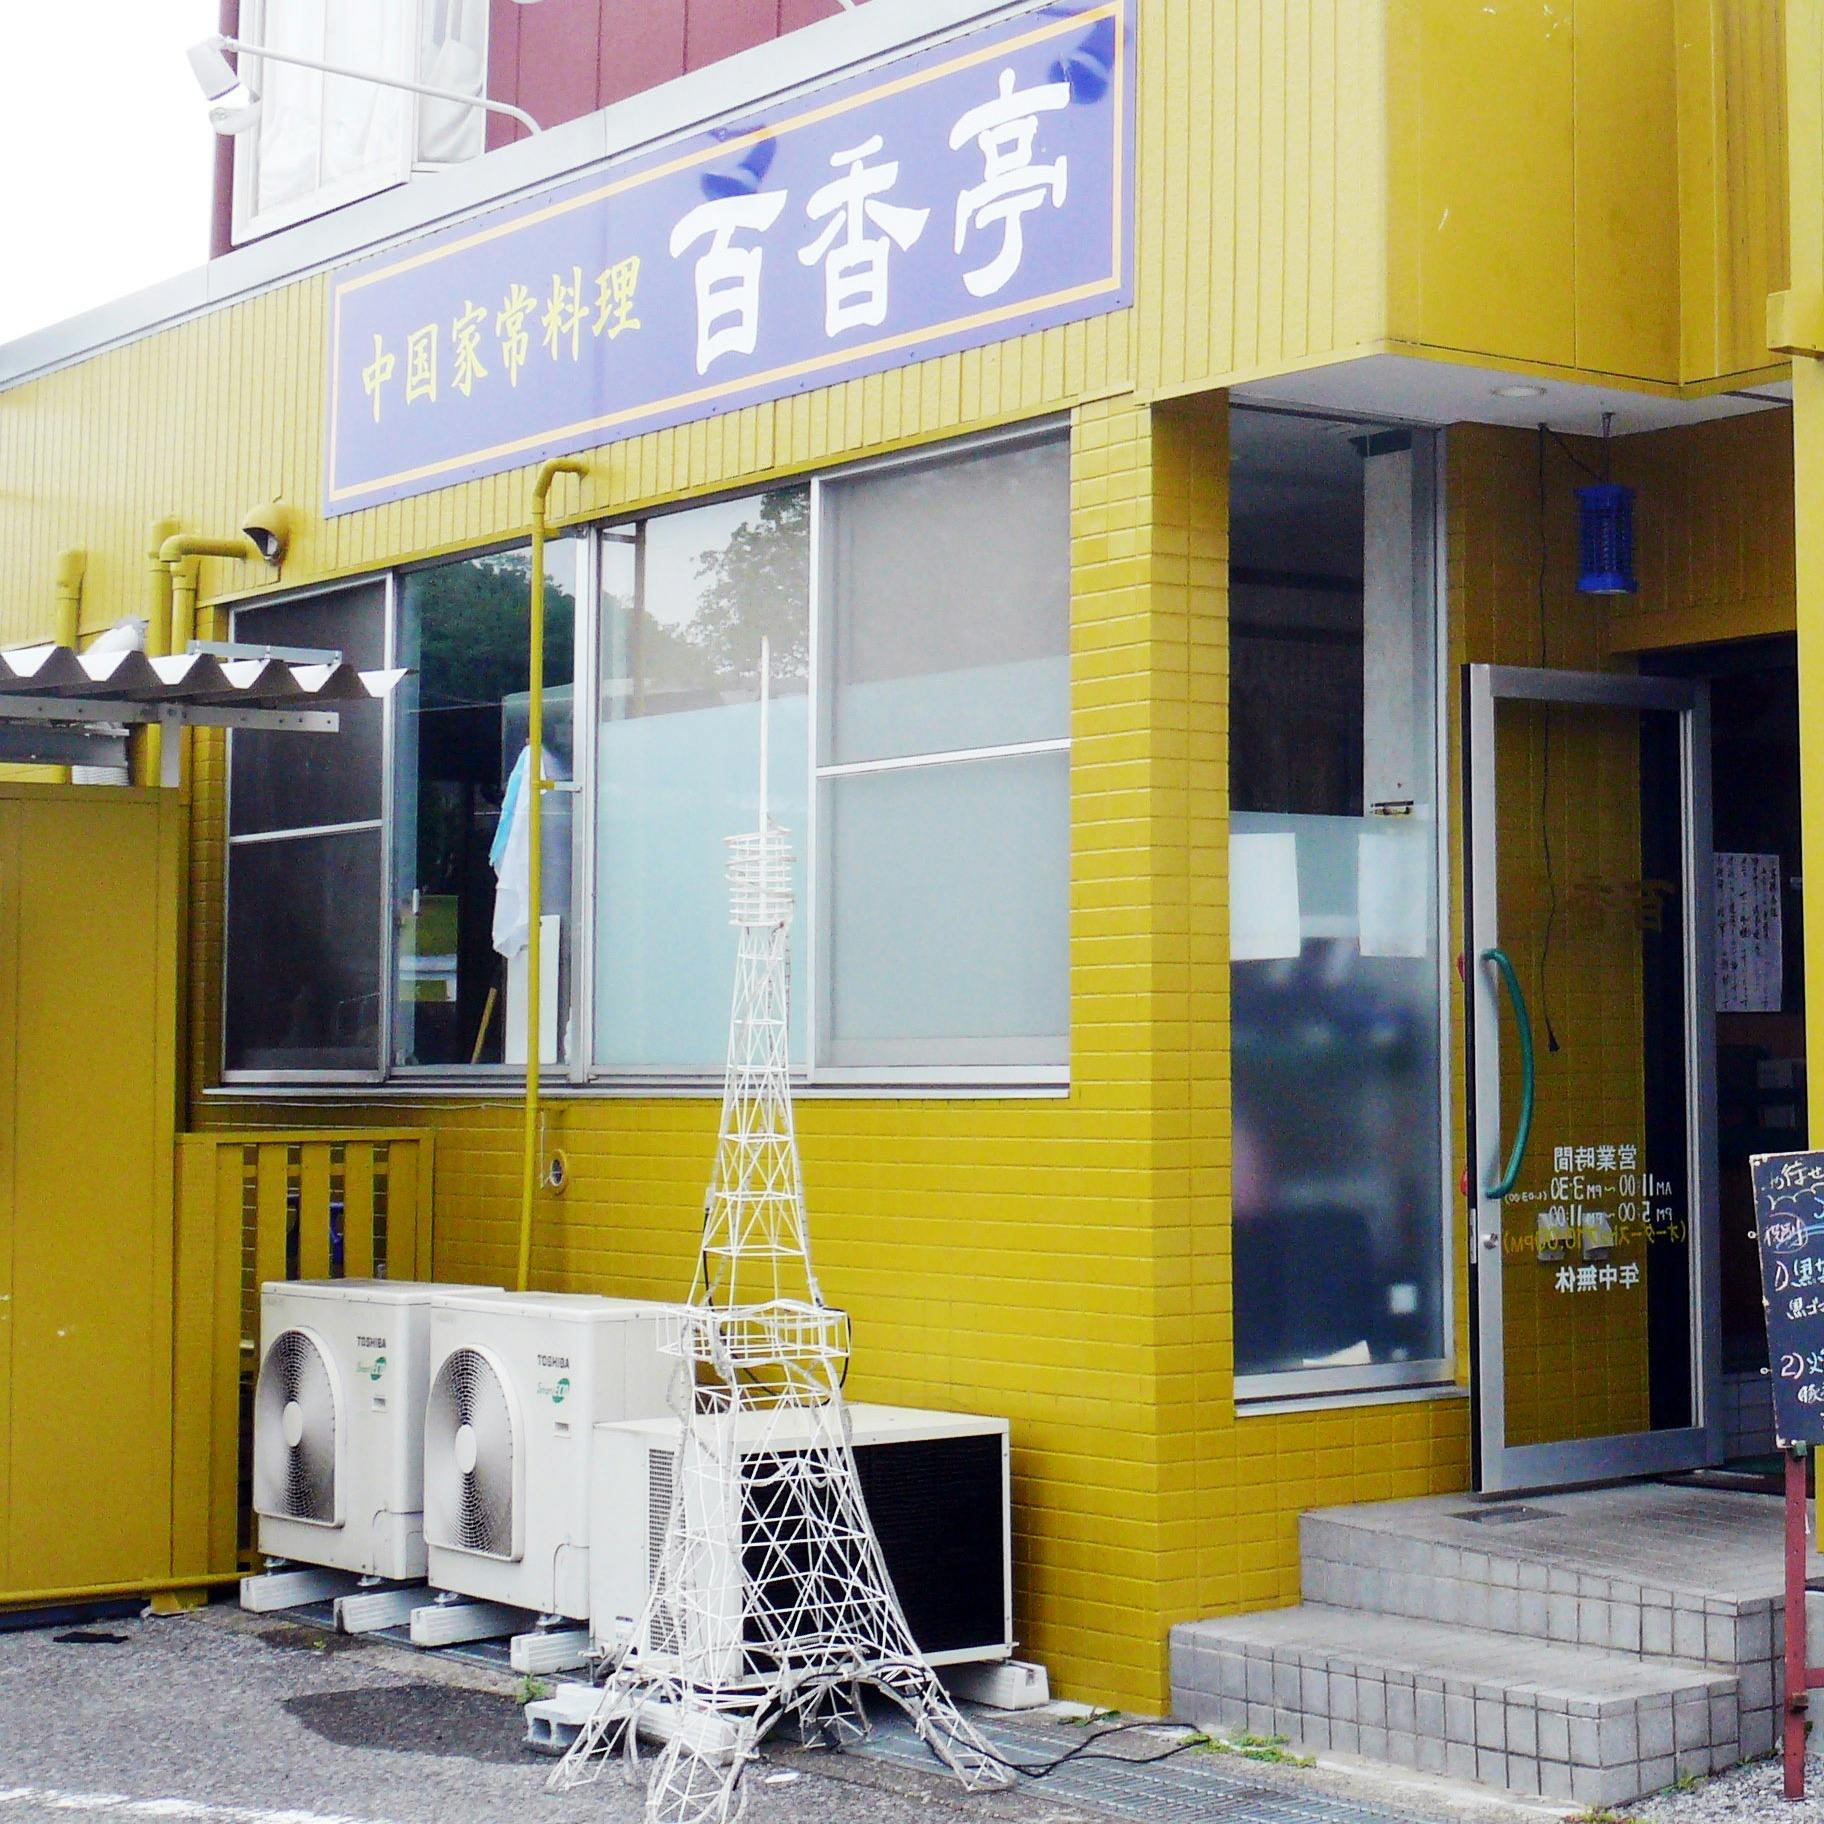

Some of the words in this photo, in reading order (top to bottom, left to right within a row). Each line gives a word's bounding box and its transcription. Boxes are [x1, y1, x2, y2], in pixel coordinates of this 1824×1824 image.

[360, 253, 642, 423] 中国家常料理
[669, 67, 1071, 376] 百香亭
